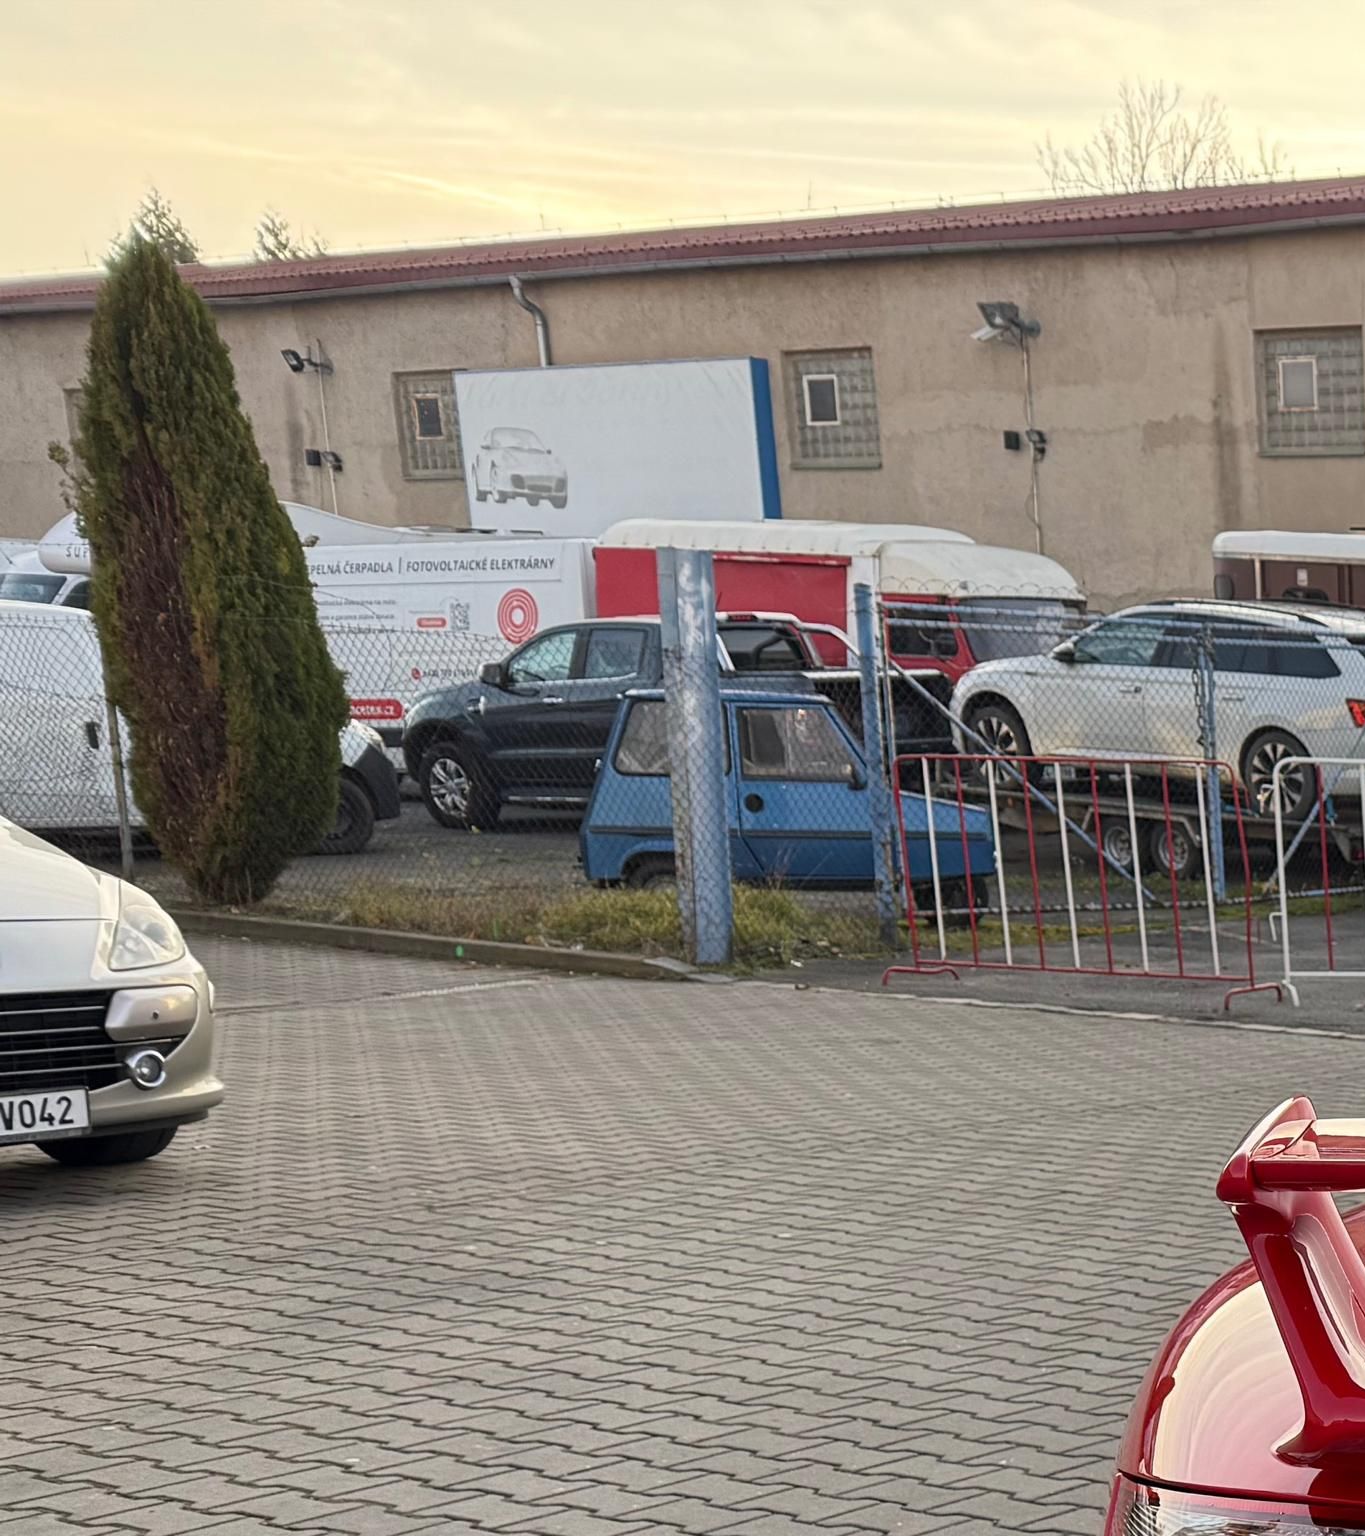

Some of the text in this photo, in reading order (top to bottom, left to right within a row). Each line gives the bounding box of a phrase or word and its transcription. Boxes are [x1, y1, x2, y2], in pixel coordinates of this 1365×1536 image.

[343, 559, 393, 575] ČERPADLA
[406, 557, 488, 573] FOTOVOLTAICKÉ
[490, 557, 556, 571] ELEKTRÁRNY
